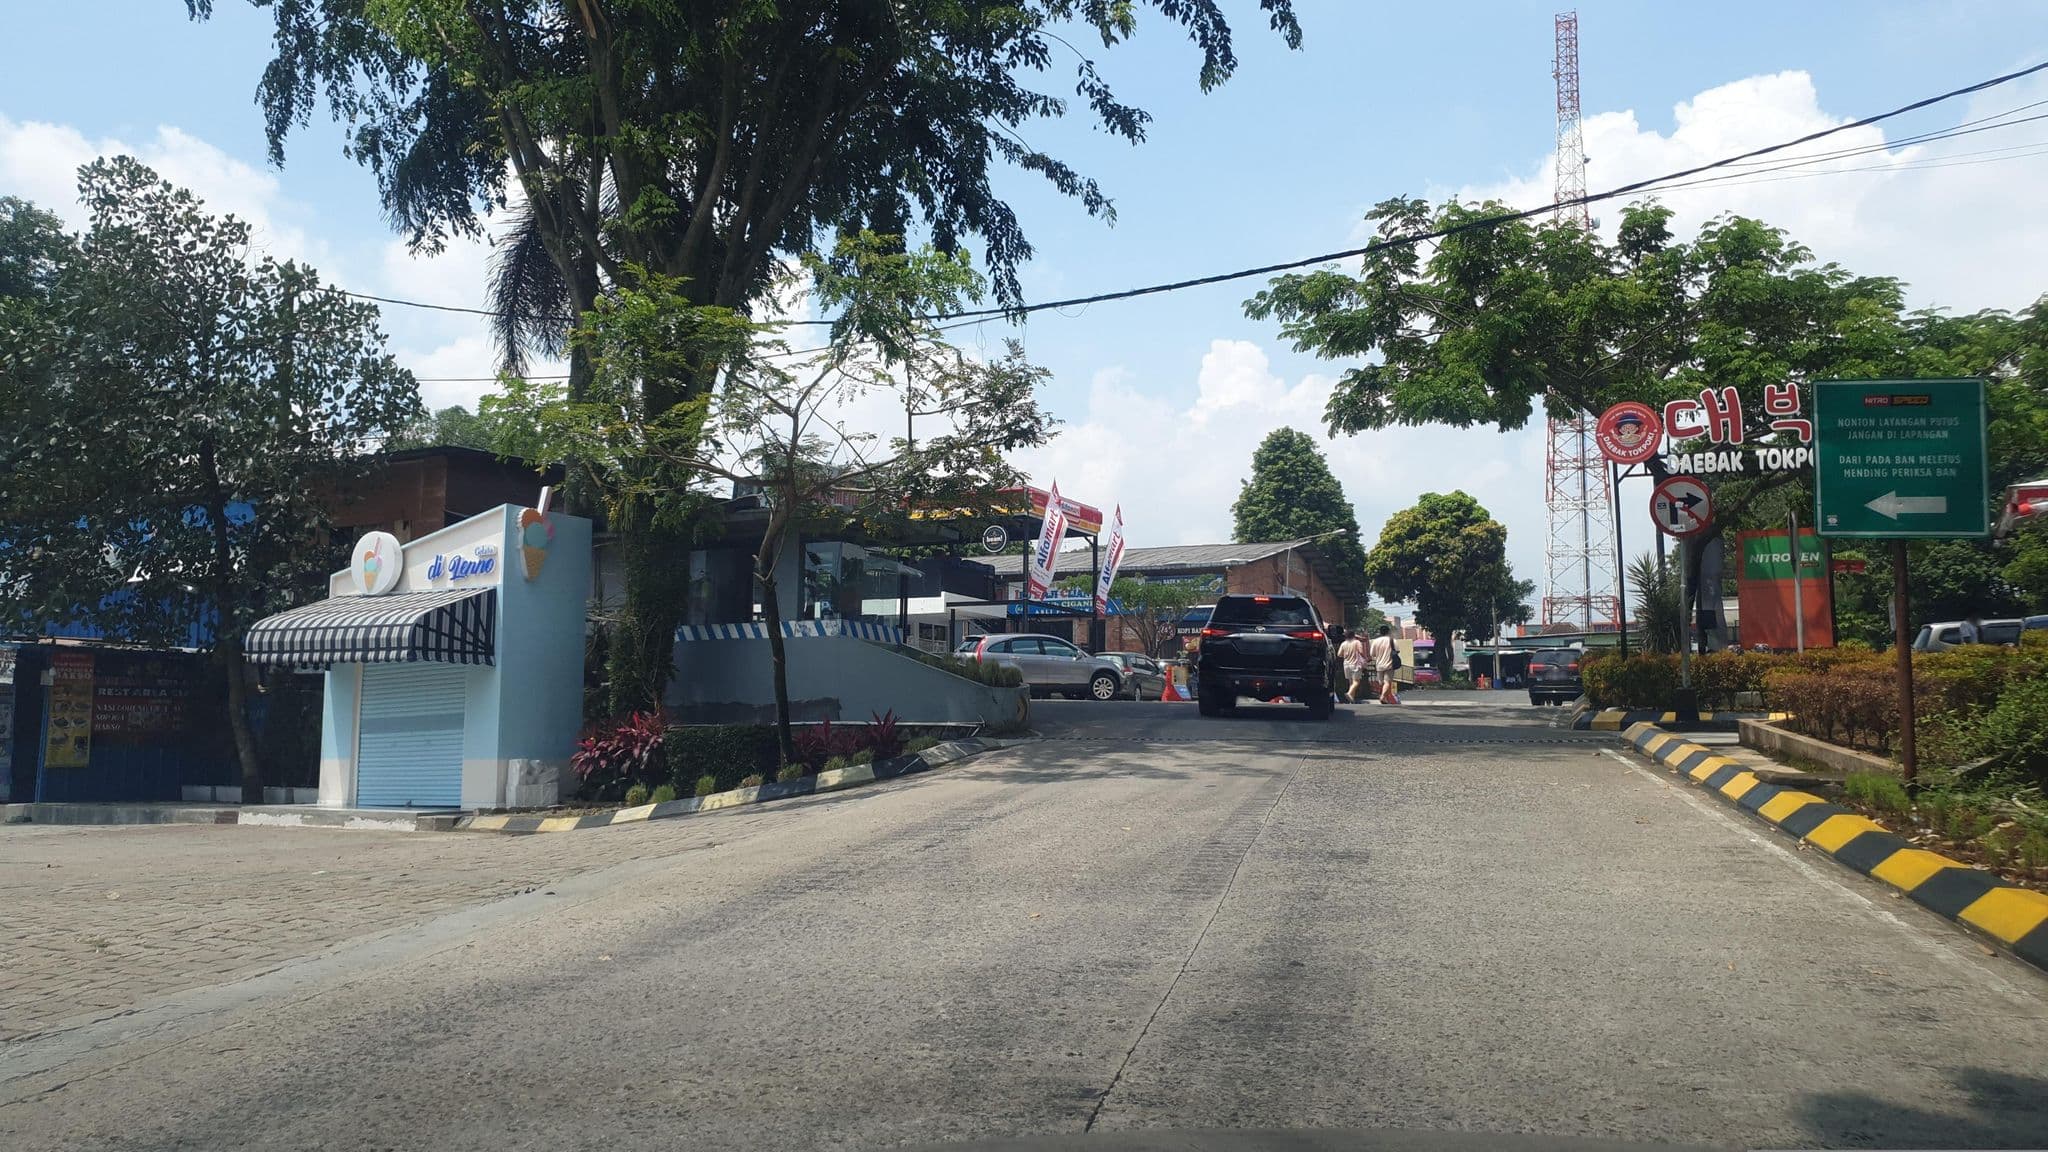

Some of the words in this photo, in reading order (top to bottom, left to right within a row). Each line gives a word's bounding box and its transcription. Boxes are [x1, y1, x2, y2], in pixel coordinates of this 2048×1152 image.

[1838, 417, 1875, 428] NONTON
[1879, 417, 1927, 427] LAYANGAN
[1930, 416, 1960, 427] PUTUS
[1848, 431, 1883, 441] JANGAN
[1887, 430, 1897, 440] DI
[1900, 430, 1949, 439] LAPANGAN
[1666, 450, 1744, 475] DAEBAK
[1839, 456, 1861, 465] DARI
[1865, 455, 1891, 465] PADA
[1895, 455, 1915, 464] BAN
[1919, 454, 1961, 464] MELETUS
[1844, 468, 1888, 478] MENDING
[1892, 467, 1932, 477] PERIKSA
[1936, 467, 1957, 477] BAN
[1037, 508, 1059, 569] Alfamart
[1102, 530, 1121, 586] Alfamart
[1749, 551, 1820, 564] NITROEN
[428, 554, 443, 580] di
